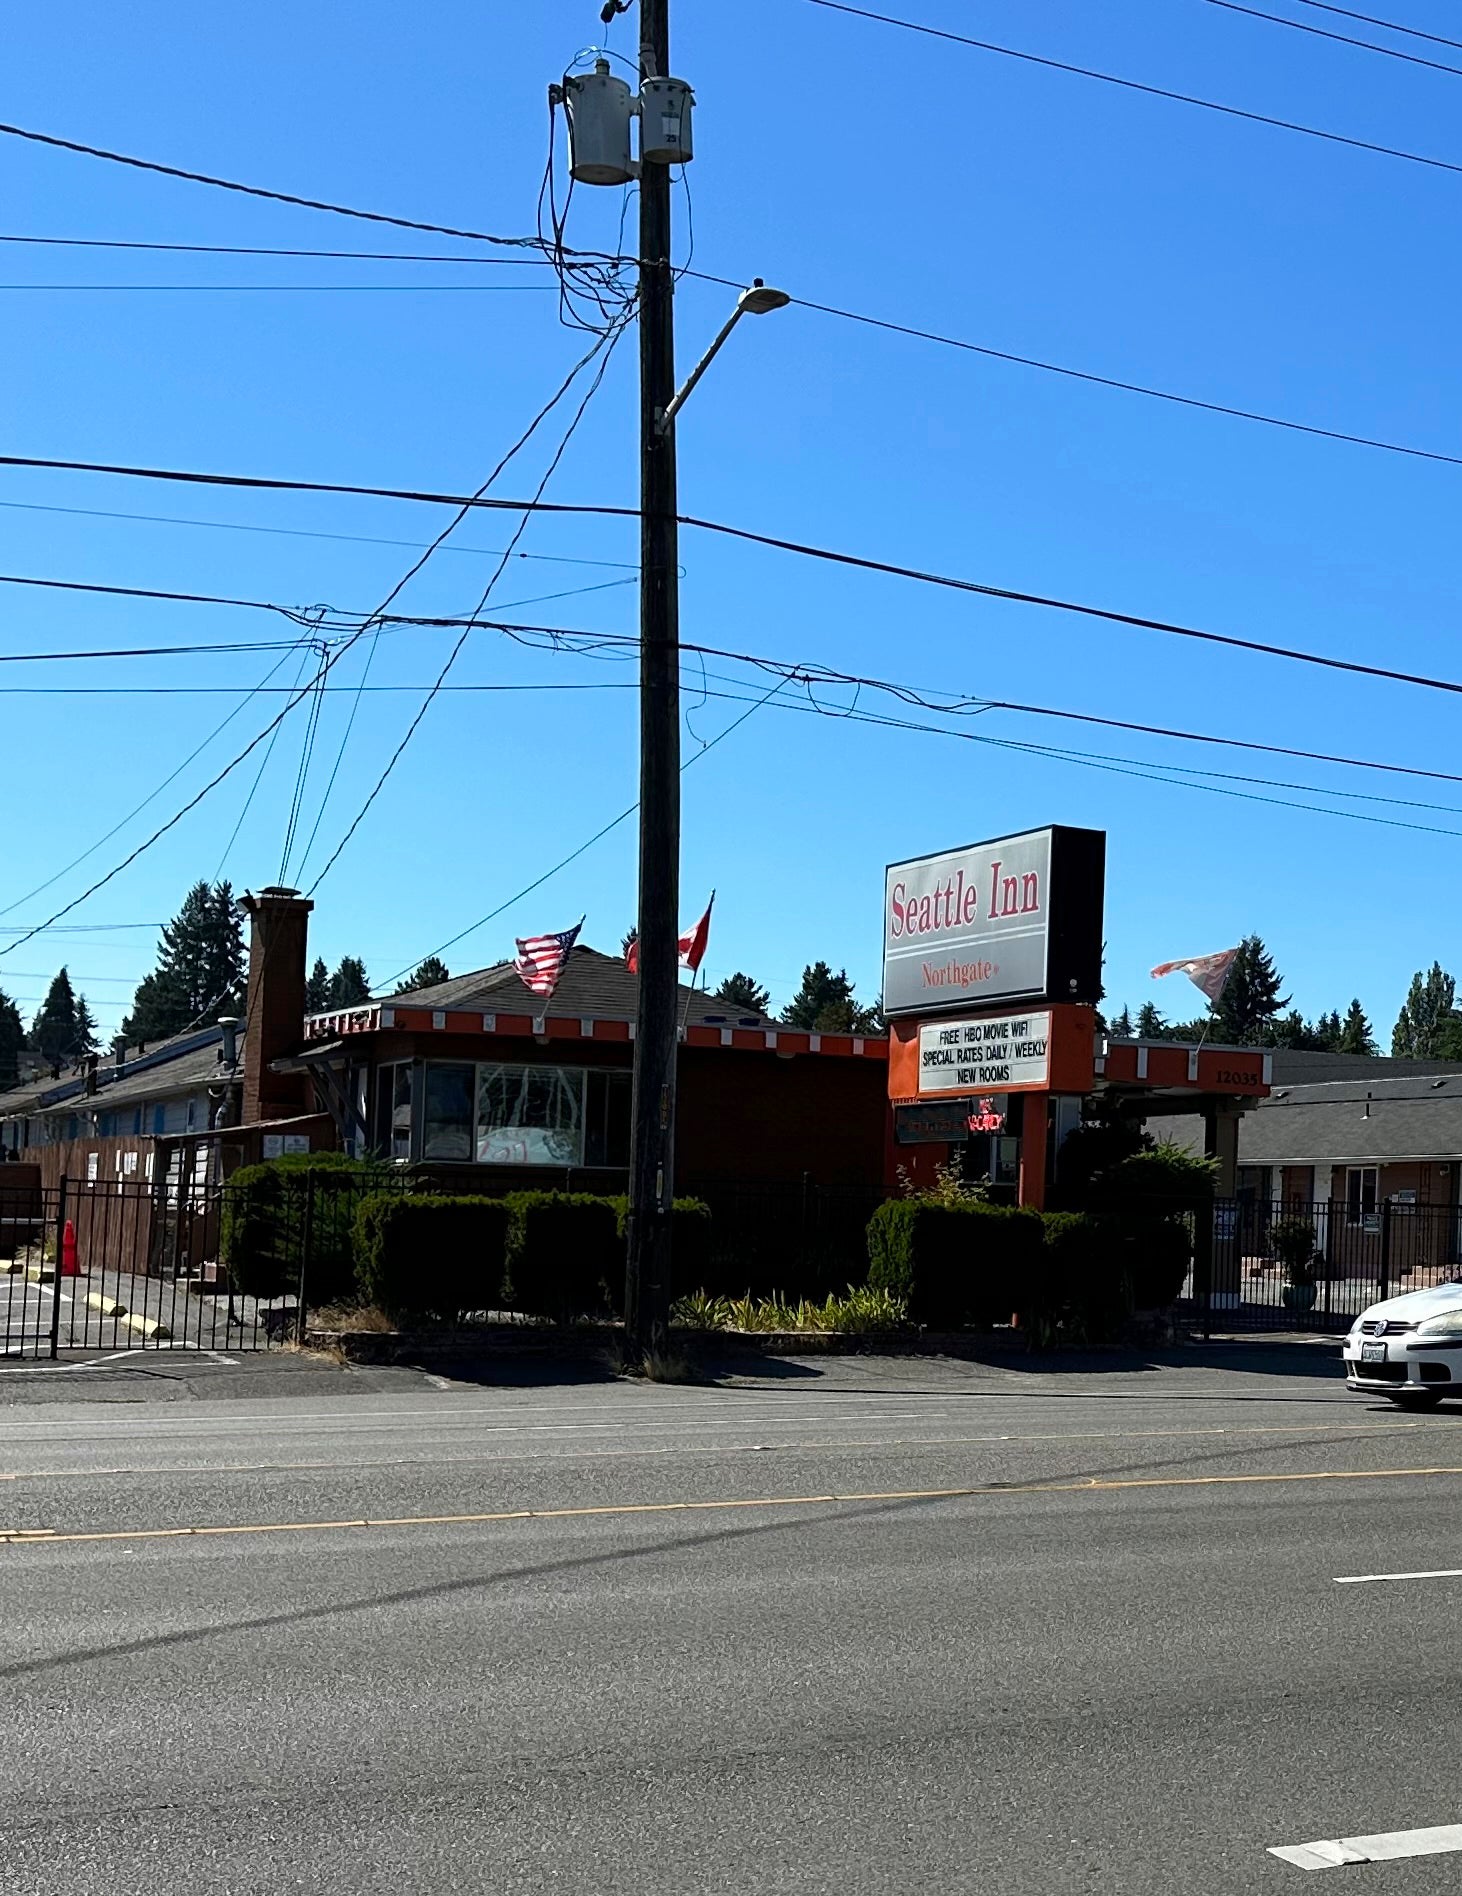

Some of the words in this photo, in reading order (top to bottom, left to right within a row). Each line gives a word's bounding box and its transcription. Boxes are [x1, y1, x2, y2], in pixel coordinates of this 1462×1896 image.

[891, 870, 978, 938] Seattle
[987, 861, 1039, 920] Inn
[921, 957, 993, 988] Northgate
[940, 1029, 960, 1046] FREE
[964, 1026, 982, 1043] HBO
[983, 1022, 1009, 1041] MOVIE
[1011, 1020, 1028, 1037] WIFI
[923, 1049, 954, 1067] SPECIAL
[957, 1046, 983, 1063] RATES
[986, 1043, 1008, 1060] DAILY
[1014, 1040, 1048, 1058] WEEKLY
[957, 1068, 976, 1084] NEW
[979, 1065, 1010, 1083] ROOMS
[1216, 1070, 1258, 1087] 12035
